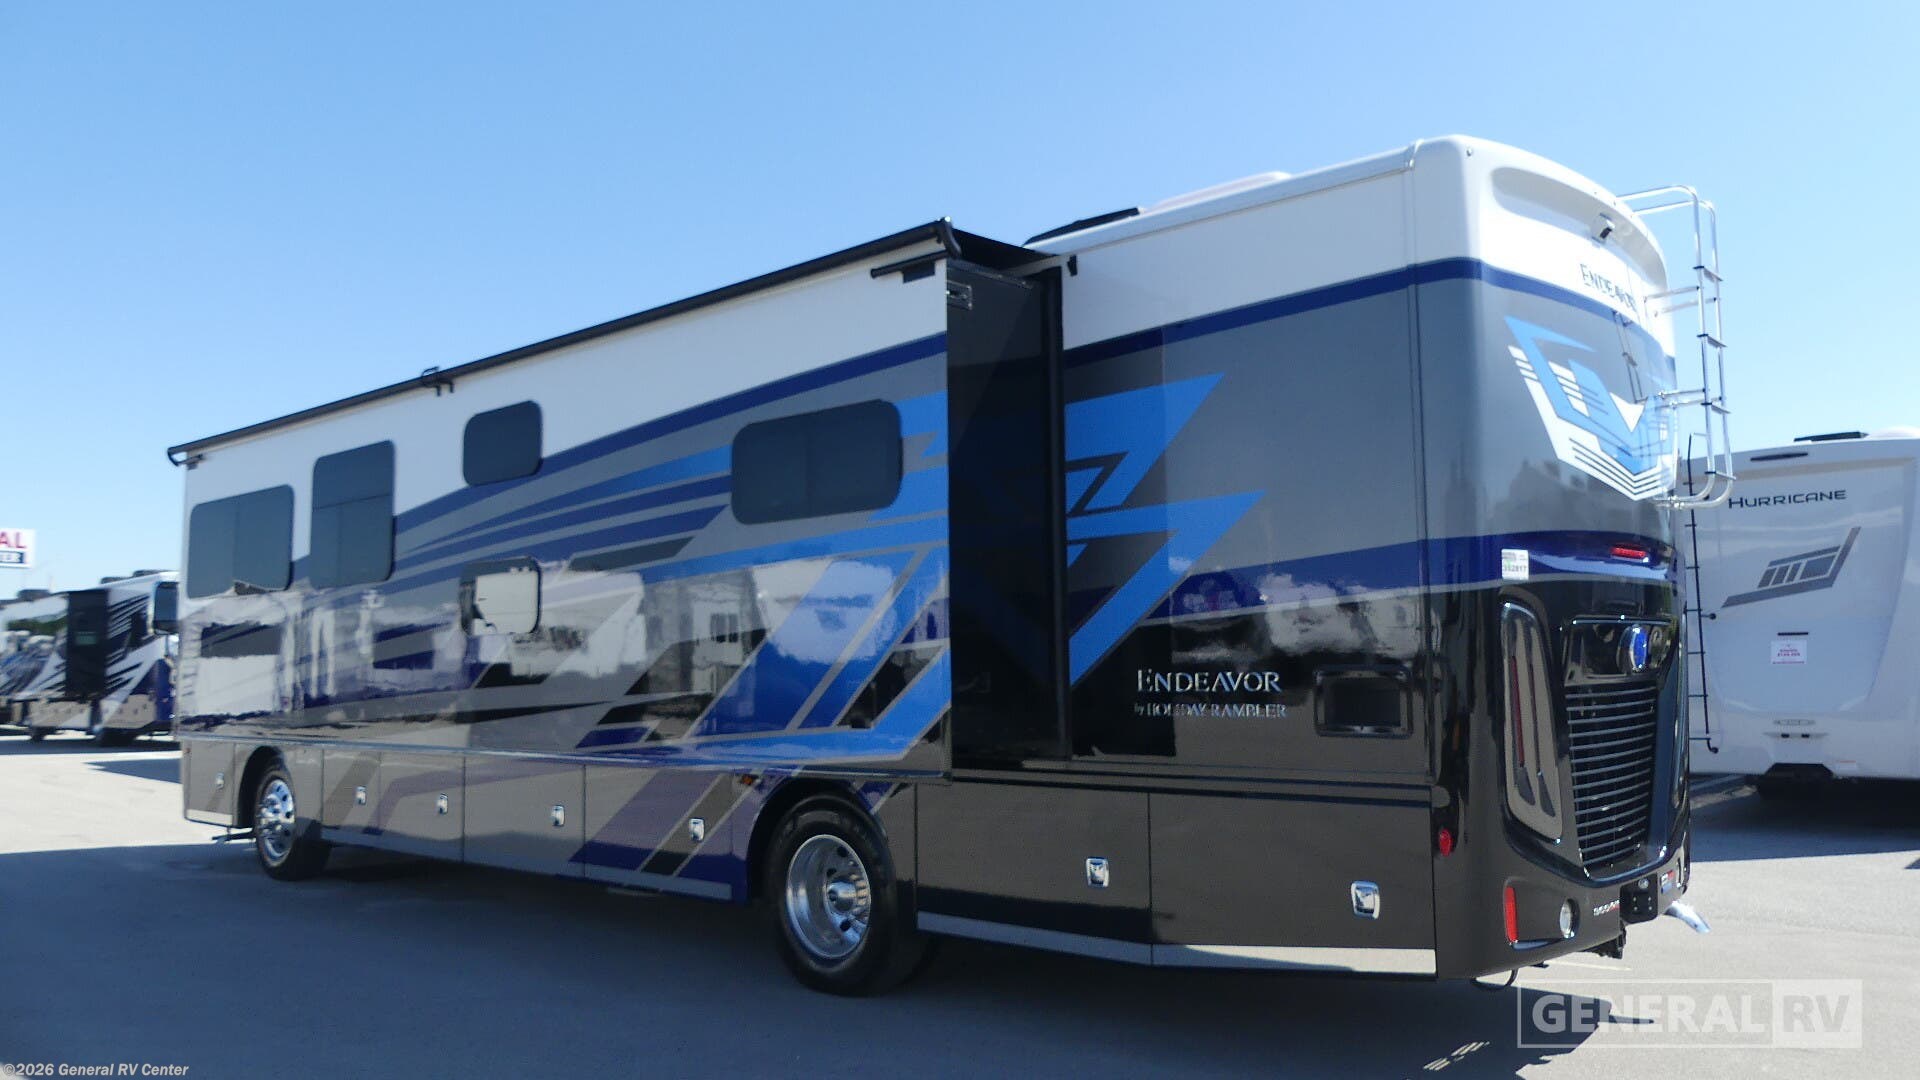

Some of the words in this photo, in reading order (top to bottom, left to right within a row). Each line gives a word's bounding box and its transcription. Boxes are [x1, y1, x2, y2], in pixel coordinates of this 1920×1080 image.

[1728, 489, 1847, 509] HURRICANE
[1137, 668, 1282, 692] ENDEAVOR
[1210, 703, 1288, 718] RAMBLER
